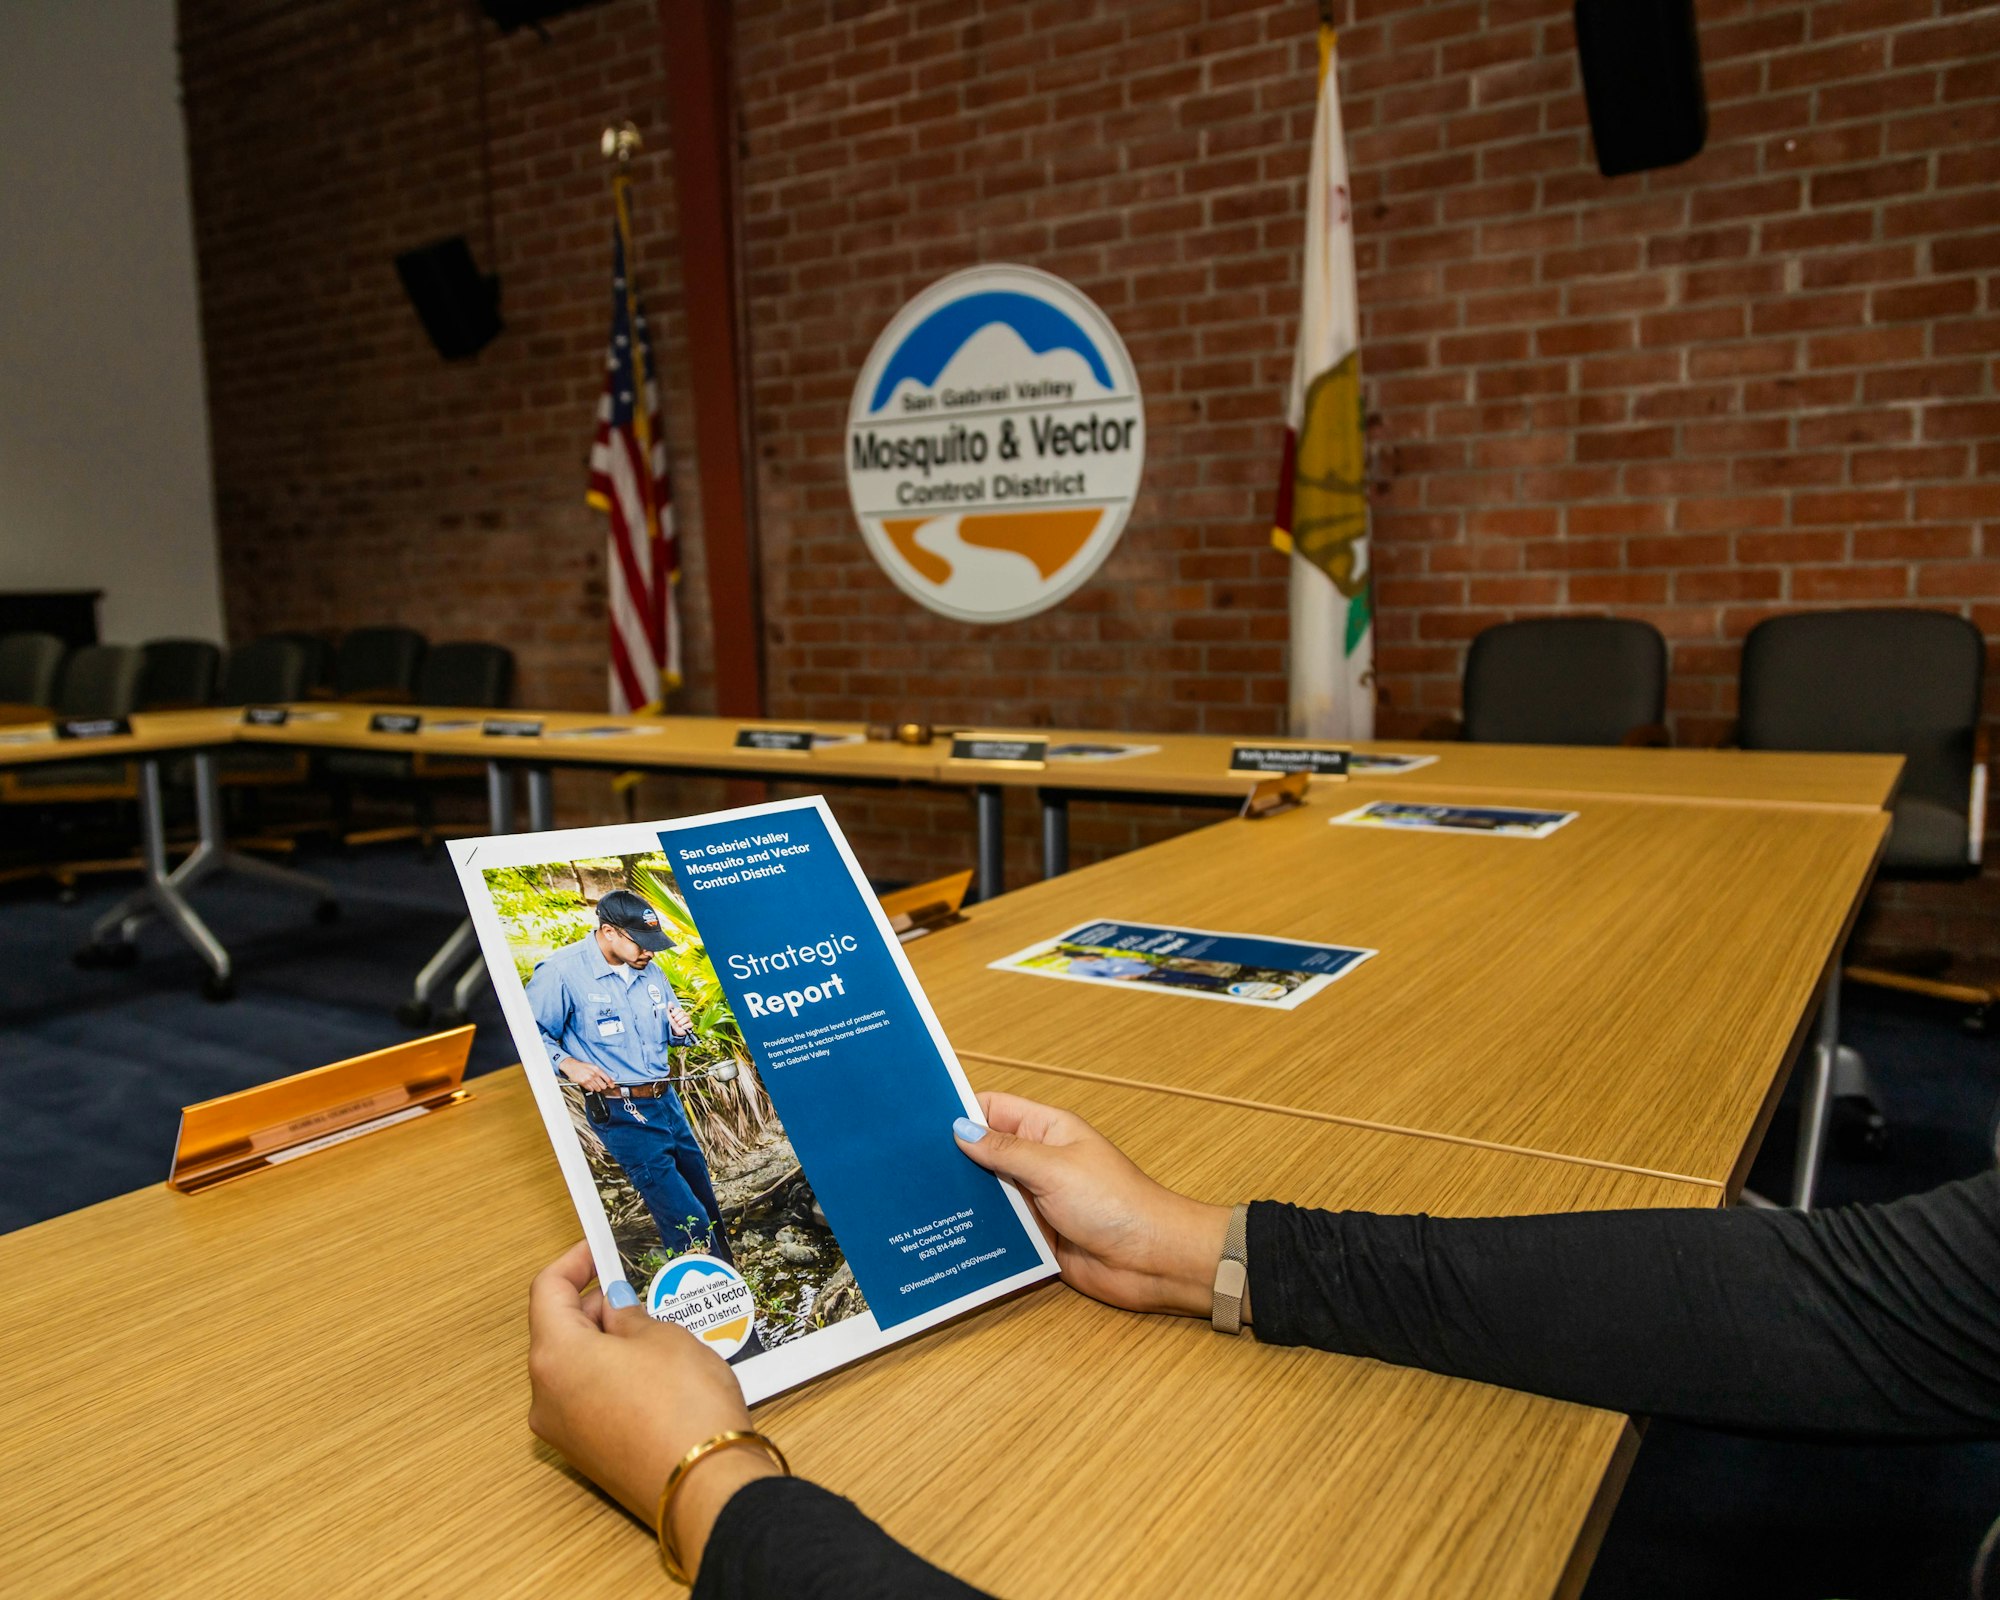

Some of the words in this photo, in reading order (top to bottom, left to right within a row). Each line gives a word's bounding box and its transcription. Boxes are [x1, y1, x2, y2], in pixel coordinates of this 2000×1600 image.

[902, 392, 936, 412] San
[941, 383, 1010, 408] Gabriel
[1015, 378, 1076, 402] Valley
[852, 424, 989, 478] Mosquito
[998, 418, 1020, 460] &
[1030, 412, 1136, 457] Vector
[896, 477, 985, 506] Control
[993, 471, 1086, 499] District
[680, 847, 704, 860] San
[707, 838, 751, 855] Gabriel
[751, 832, 789, 846] Valley
[686, 856, 744, 876] Mosquito
[747, 850, 770, 864] and
[770, 842, 810, 858] Vector
[693, 873, 740, 891] Control
[742, 864, 786, 880] District
[728, 933, 857, 980] Strategic
[743, 973, 846, 1018] Report
[763, 1035, 794, 1048] Providing
[795, 1033, 805, 1041] the
[805, 1025, 829, 1037] highest
[829, 1020, 845, 1031] level
[846, 1018, 853, 1026] of
[853, 1009, 886, 1025] protection
[768, 1050, 783, 1059] from
[784, 1043, 808, 1054] vectors
[814, 1029, 855, 1046] vector-borne
[855, 1021, 883, 1035] diseases
[772, 1061, 786, 1070] San
[786, 1053, 810, 1065] Gabriel
[809, 1048, 830, 1059] Valley
[889, 1234, 904, 1245] 1145
[913, 1224, 933, 1236] Azusa
[933, 1215, 957, 1229] Canyon
[957, 1208, 974, 1220] Road
[901, 1242, 919, 1254] West
[919, 1233, 944, 1247] Covina,
[943, 1227, 954, 1238] CA
[953, 1221, 973, 1233] 91790
[919, 1248, 937, 1261] (626)
[937, 1236, 967, 1253] 814-9466
[899, 1267, 958, 1295] SGVmosquito.org
[960, 1247, 1007, 1270] @SGVmosquito
[664, 1298, 680, 1307] San
[680, 1286, 706, 1300] Gabriel
[706, 1278, 729, 1290] Valley
[704, 1297, 713, 1310] &
[712, 1285, 748, 1305] Vector
[686, 1316, 707, 1331] ntrol
[709, 1305, 742, 1323] District
